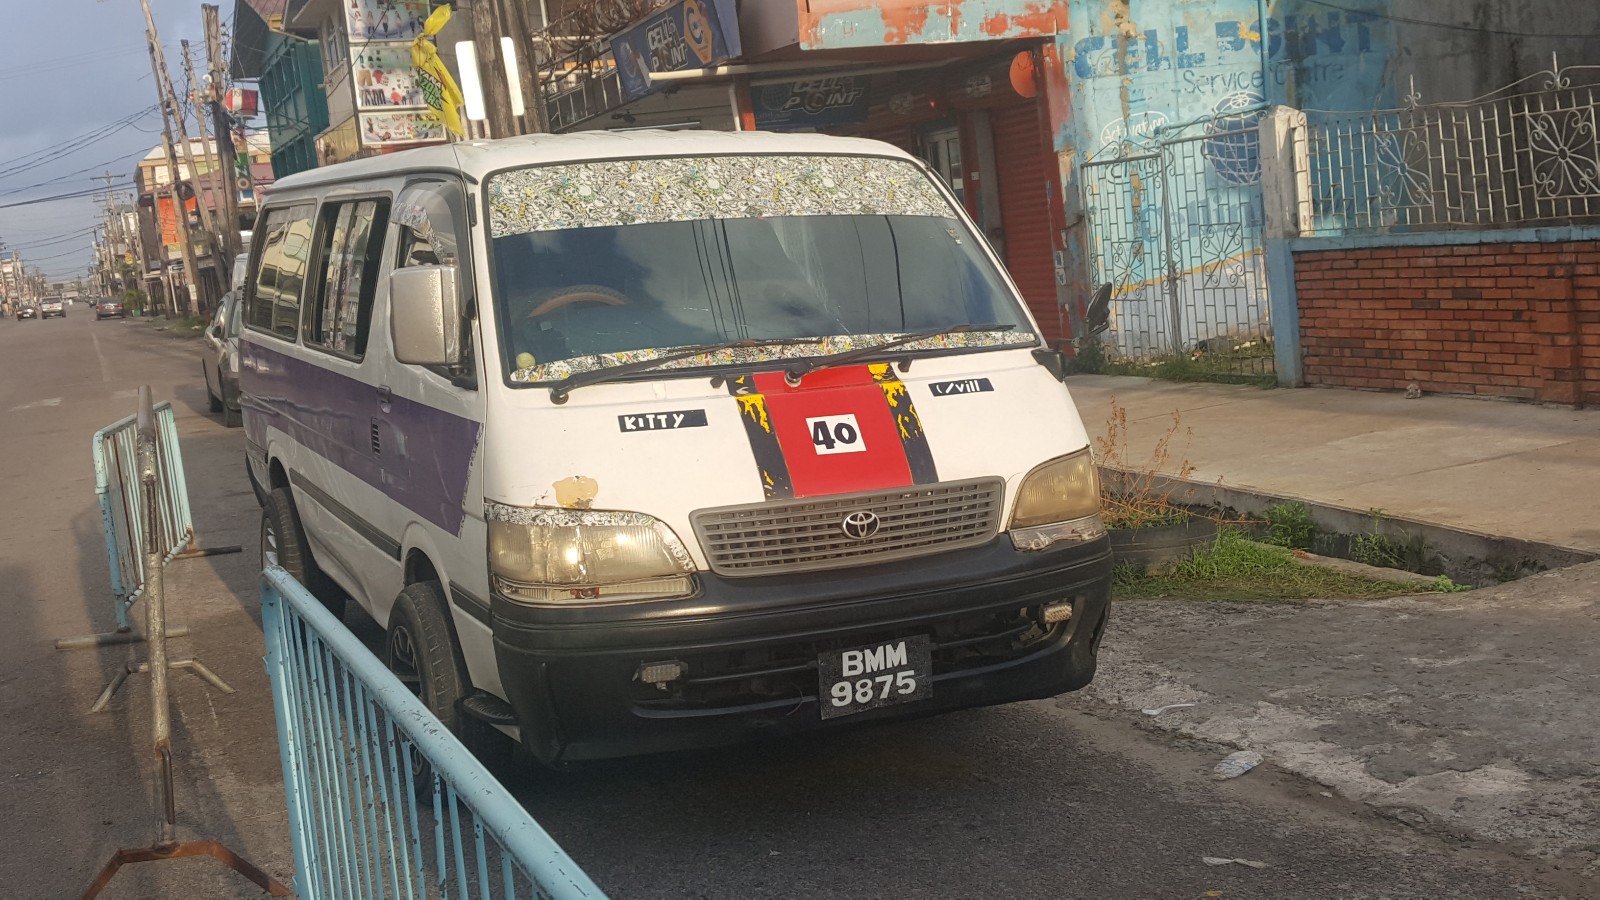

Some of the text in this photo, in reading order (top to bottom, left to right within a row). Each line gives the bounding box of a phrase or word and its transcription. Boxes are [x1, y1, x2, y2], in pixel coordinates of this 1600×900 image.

[647, 18, 673, 50] CELL
[792, 78, 842, 93] CELL
[1183, 69, 1263, 94] Service
[812, 420, 858, 450] 40
[842, 641, 908, 677] BMM
[831, 670, 916, 707] 9875
